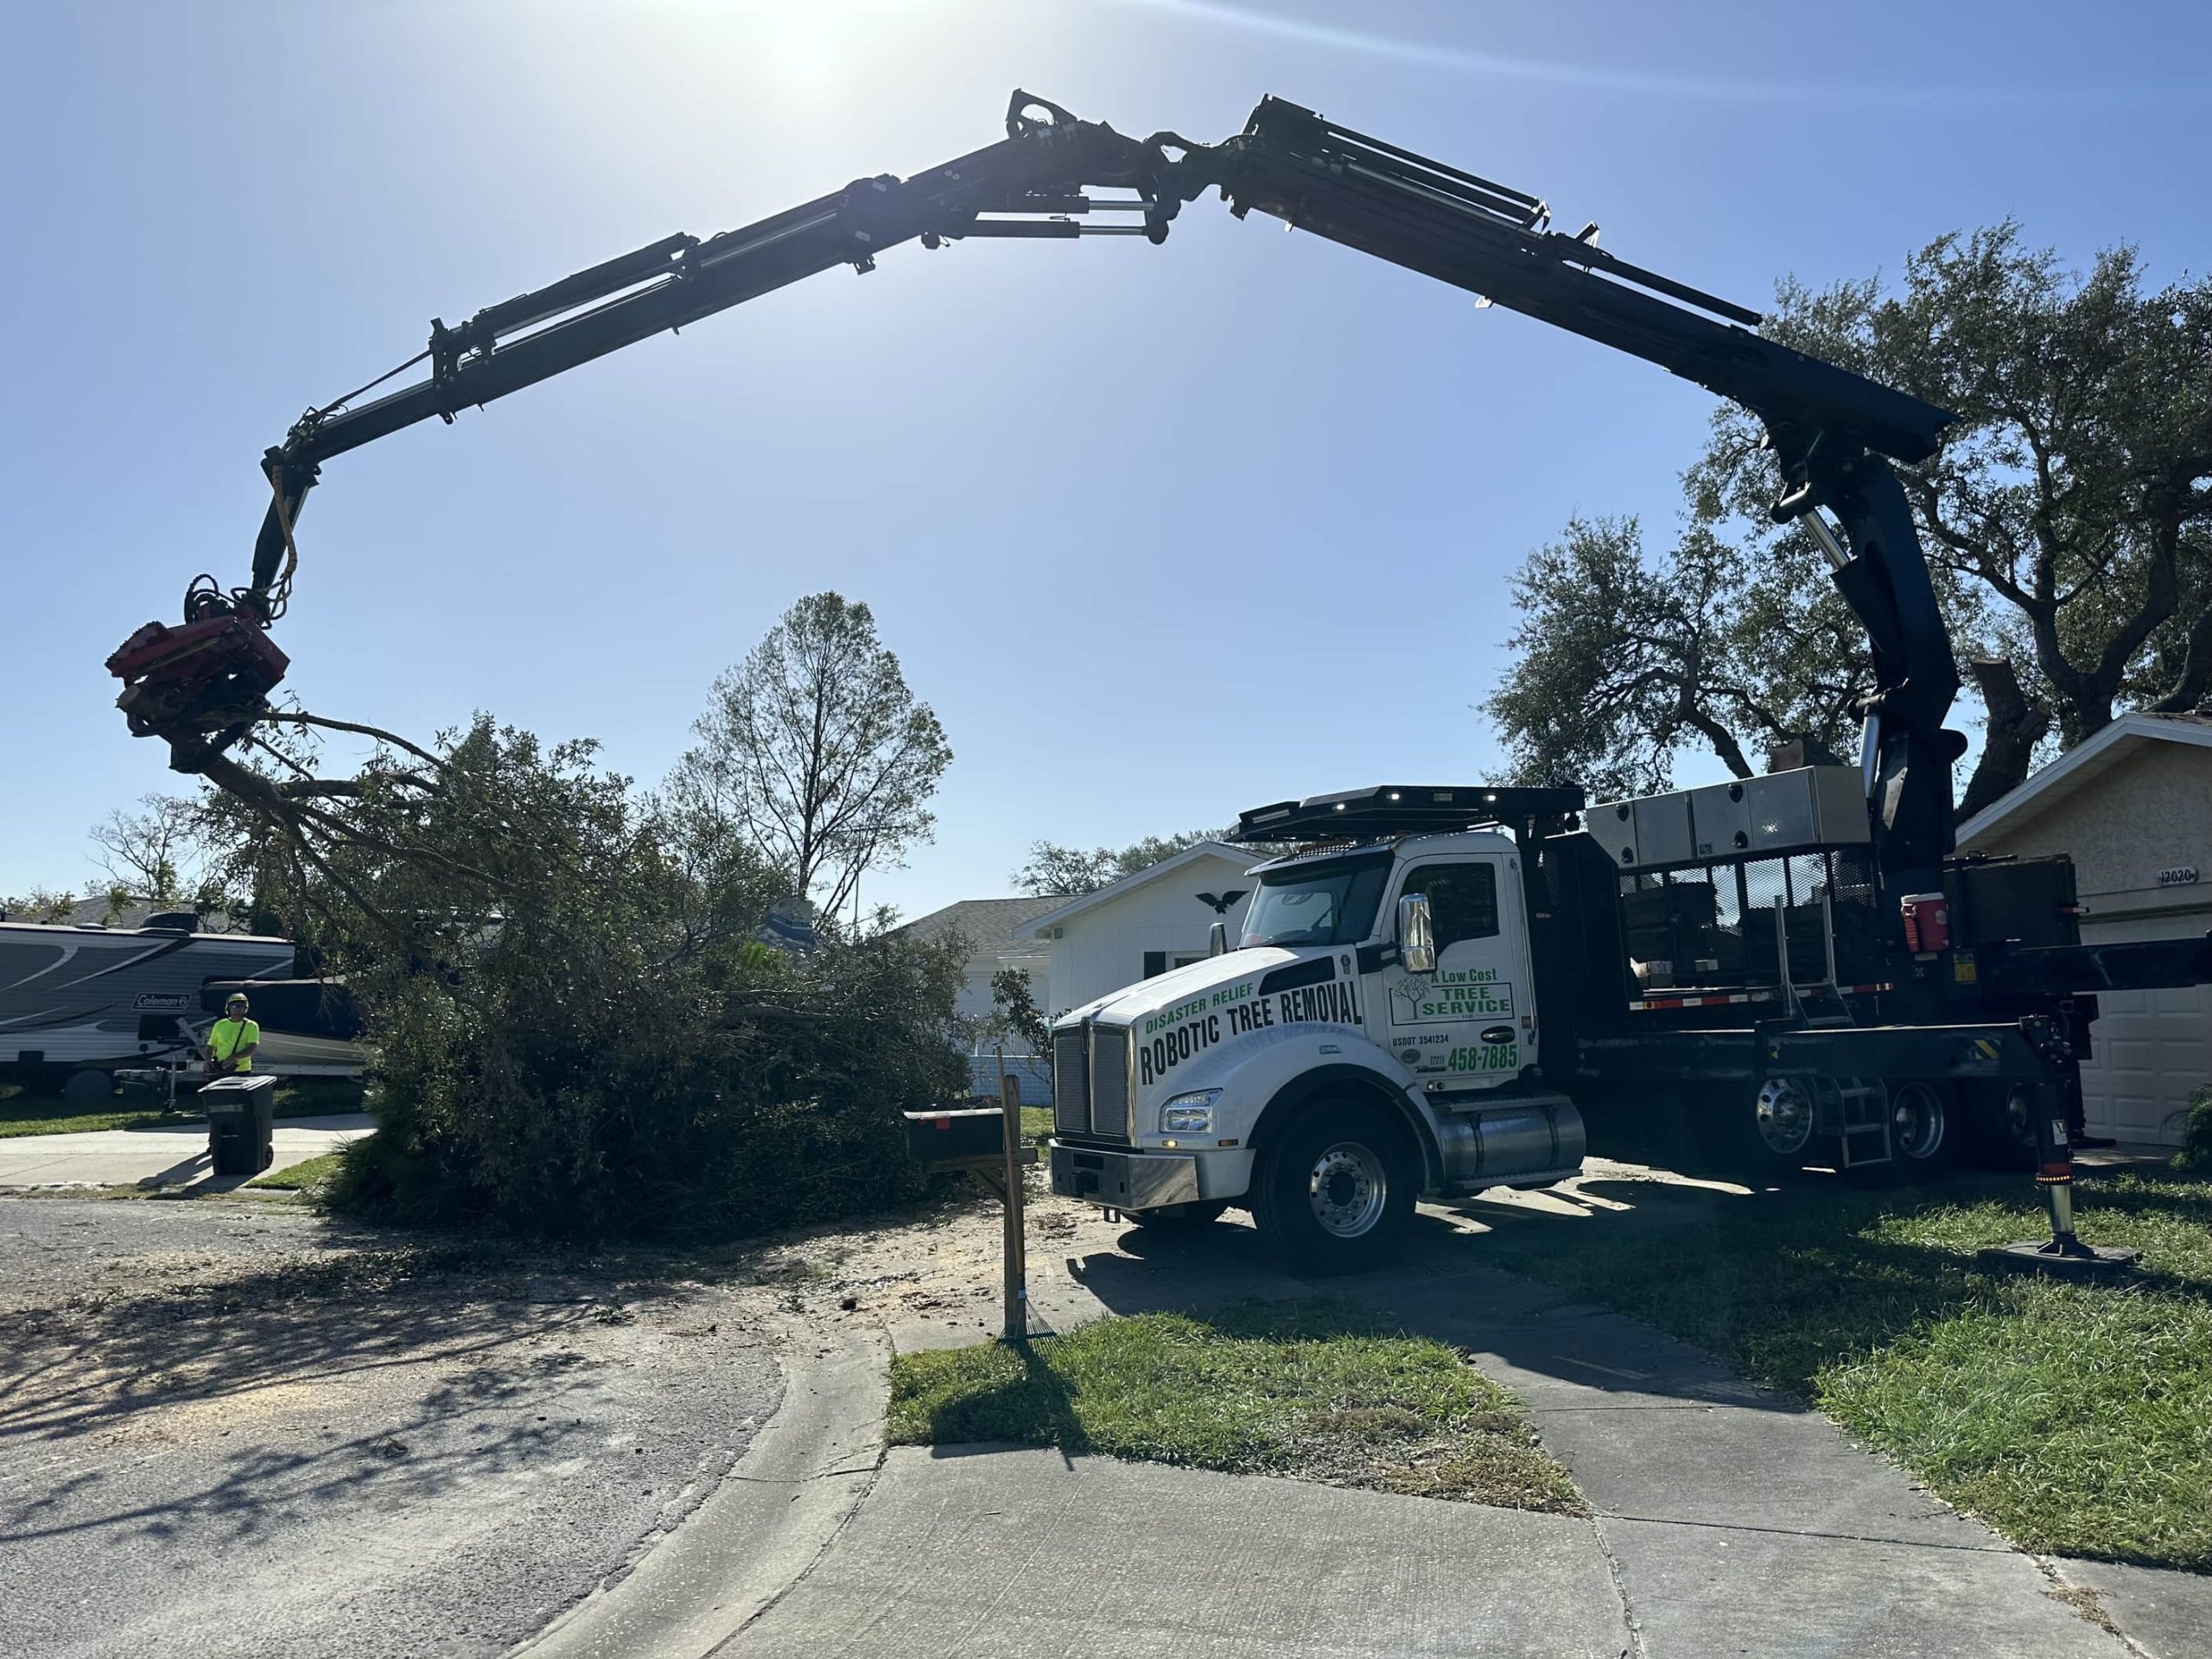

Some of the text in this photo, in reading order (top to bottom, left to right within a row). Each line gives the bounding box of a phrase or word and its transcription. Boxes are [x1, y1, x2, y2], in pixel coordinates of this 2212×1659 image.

[2161, 868, 2191, 884] 12020
[1431, 968, 1497, 983] A Low Cost
[137, 994, 178, 1006] Coleman
[1441, 987, 1491, 1001] TREE
[1146, 982, 1254, 1035] DISASTER RELIEF
[1421, 999, 1511, 1016] SERVICE
[1140, 981, 1363, 1086] ROBOTIC TREE REMOVAL
[1393, 1034, 1449, 1046] USDOT 3541234
[1448, 1045, 1517, 1071] 458-7885
